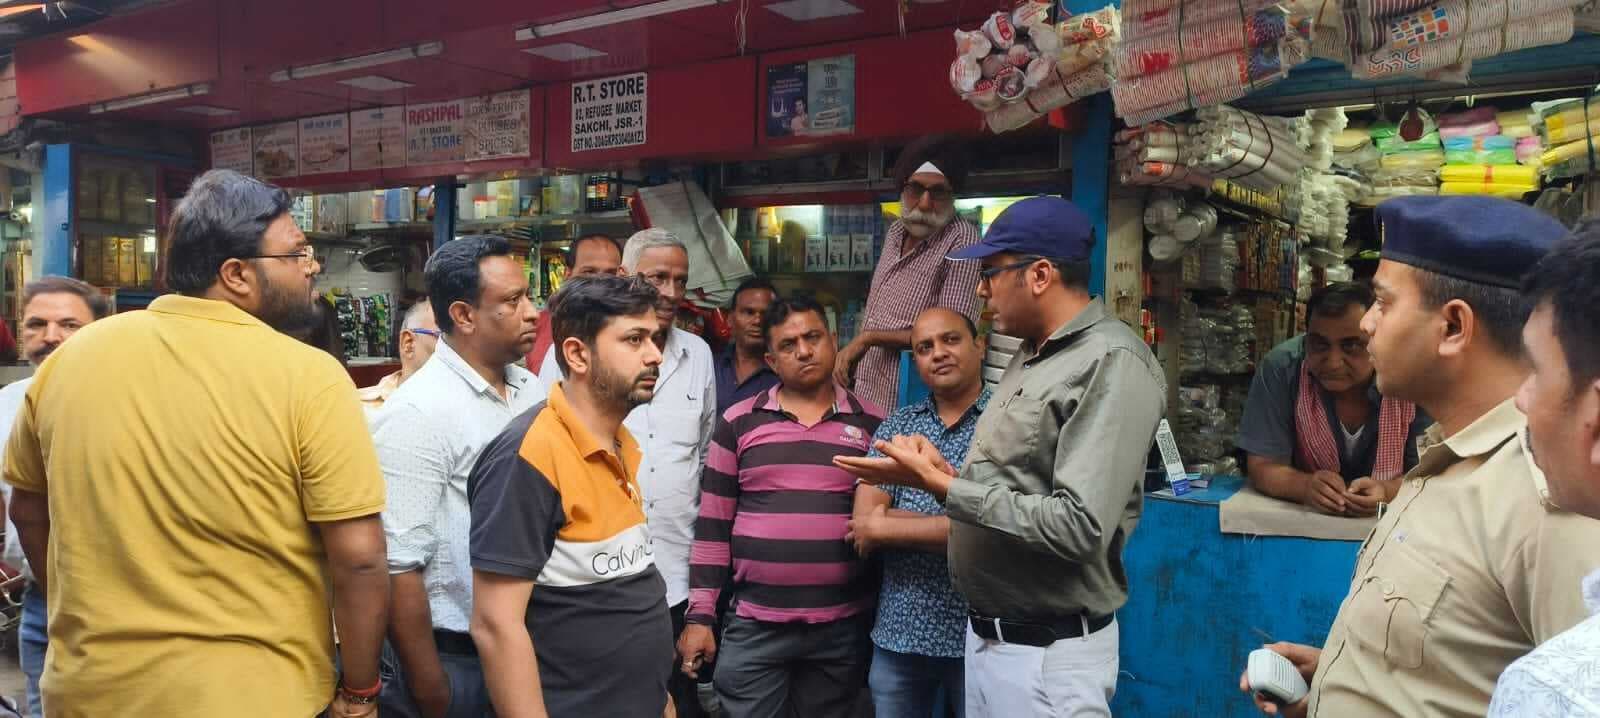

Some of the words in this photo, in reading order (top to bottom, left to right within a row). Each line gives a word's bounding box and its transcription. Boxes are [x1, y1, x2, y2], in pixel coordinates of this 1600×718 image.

[600, 76, 644, 99] STORE
[409, 103, 463, 126] RASHPAL
[586, 104, 612, 119] REFUGEE
[575, 120, 612, 134] SAKCHI,
[432, 134, 461, 149] STORE
[479, 135, 513, 151] SPICES
